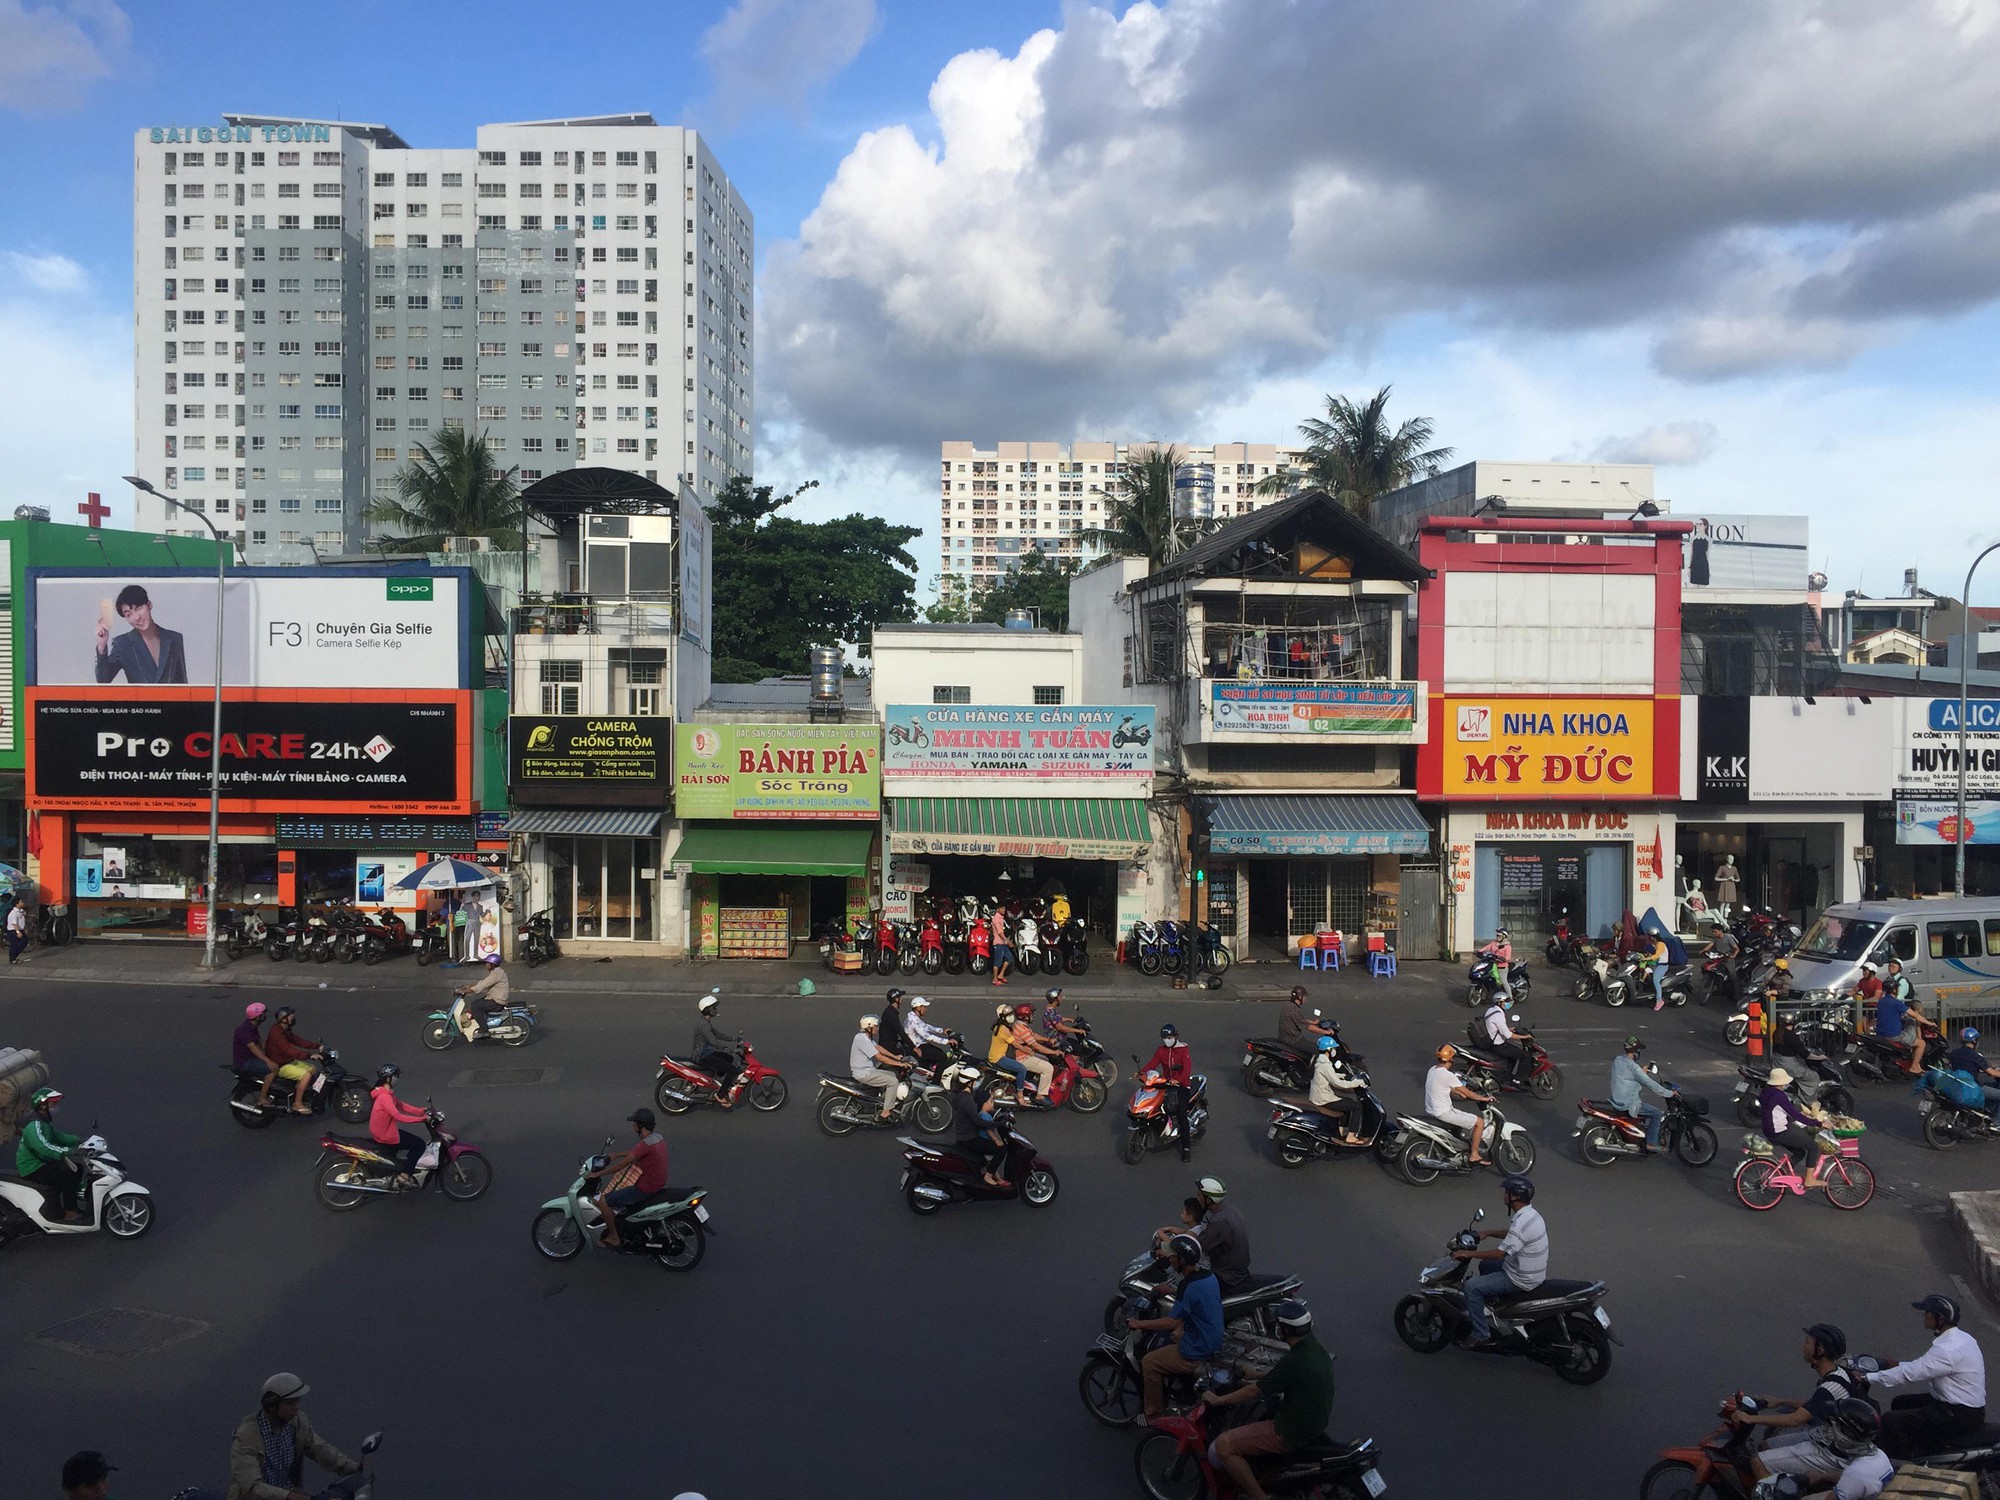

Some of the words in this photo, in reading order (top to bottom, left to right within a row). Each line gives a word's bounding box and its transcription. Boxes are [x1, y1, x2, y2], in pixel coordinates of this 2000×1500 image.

[150, 125, 251, 143] SAIGON
[260, 125, 330, 143] TOWN
[390, 585, 429, 593] oppo
[269, 621, 302, 647] F3
[316, 622, 366, 637] Chuyên
[370, 623, 391, 635] Gia
[395, 623, 433, 635] Selfie
[316, 638, 353, 649] Camera
[355, 639, 381, 649] Selfie
[1295, 691, 1316, 700] SINH
[926, 708, 959, 722] CỬA
[964, 708, 1010, 723] HÀNG
[1014, 711, 1035, 722] XE
[1078, 709, 1115, 722] MÁY
[587, 721, 637, 732] CAMERA
[1313, 719, 1329, 730] 02
[1503, 713, 1555, 735] NHA
[1562, 713, 1629, 735] KHOA
[570, 732, 615, 748] CHỐNG
[616, 734, 653, 750] TRỘM
[932, 729, 1021, 748] MINH
[1028, 723, 1111, 748] TUẤN
[183, 731, 305, 759] CARE
[738, 742, 815, 774] BÁNH
[822, 743, 868, 774] PÍA
[930, 751, 948, 759] MUA
[977, 751, 999, 759] TRAO
[1136, 752, 1148, 760] GA
[911, 760, 956, 768] HONDA
[971, 761, 1028, 769] YAMAHA
[1464, 745, 1529, 783] MỸ
[1541, 745, 1633, 783] ĐỨC
[1706, 757, 1747, 778] K&K
[80, 769, 105, 782] ĐIỆN
[356, 774, 407, 783] CAMERA
[761, 780, 792, 791] Sóc
[798, 780, 848, 793] Trăng
[1486, 811, 1520, 830] NHA
[1522, 811, 1565, 830] KHOA
[1640, 883, 1650, 892] EM
[885, 891, 907, 901] CAO
